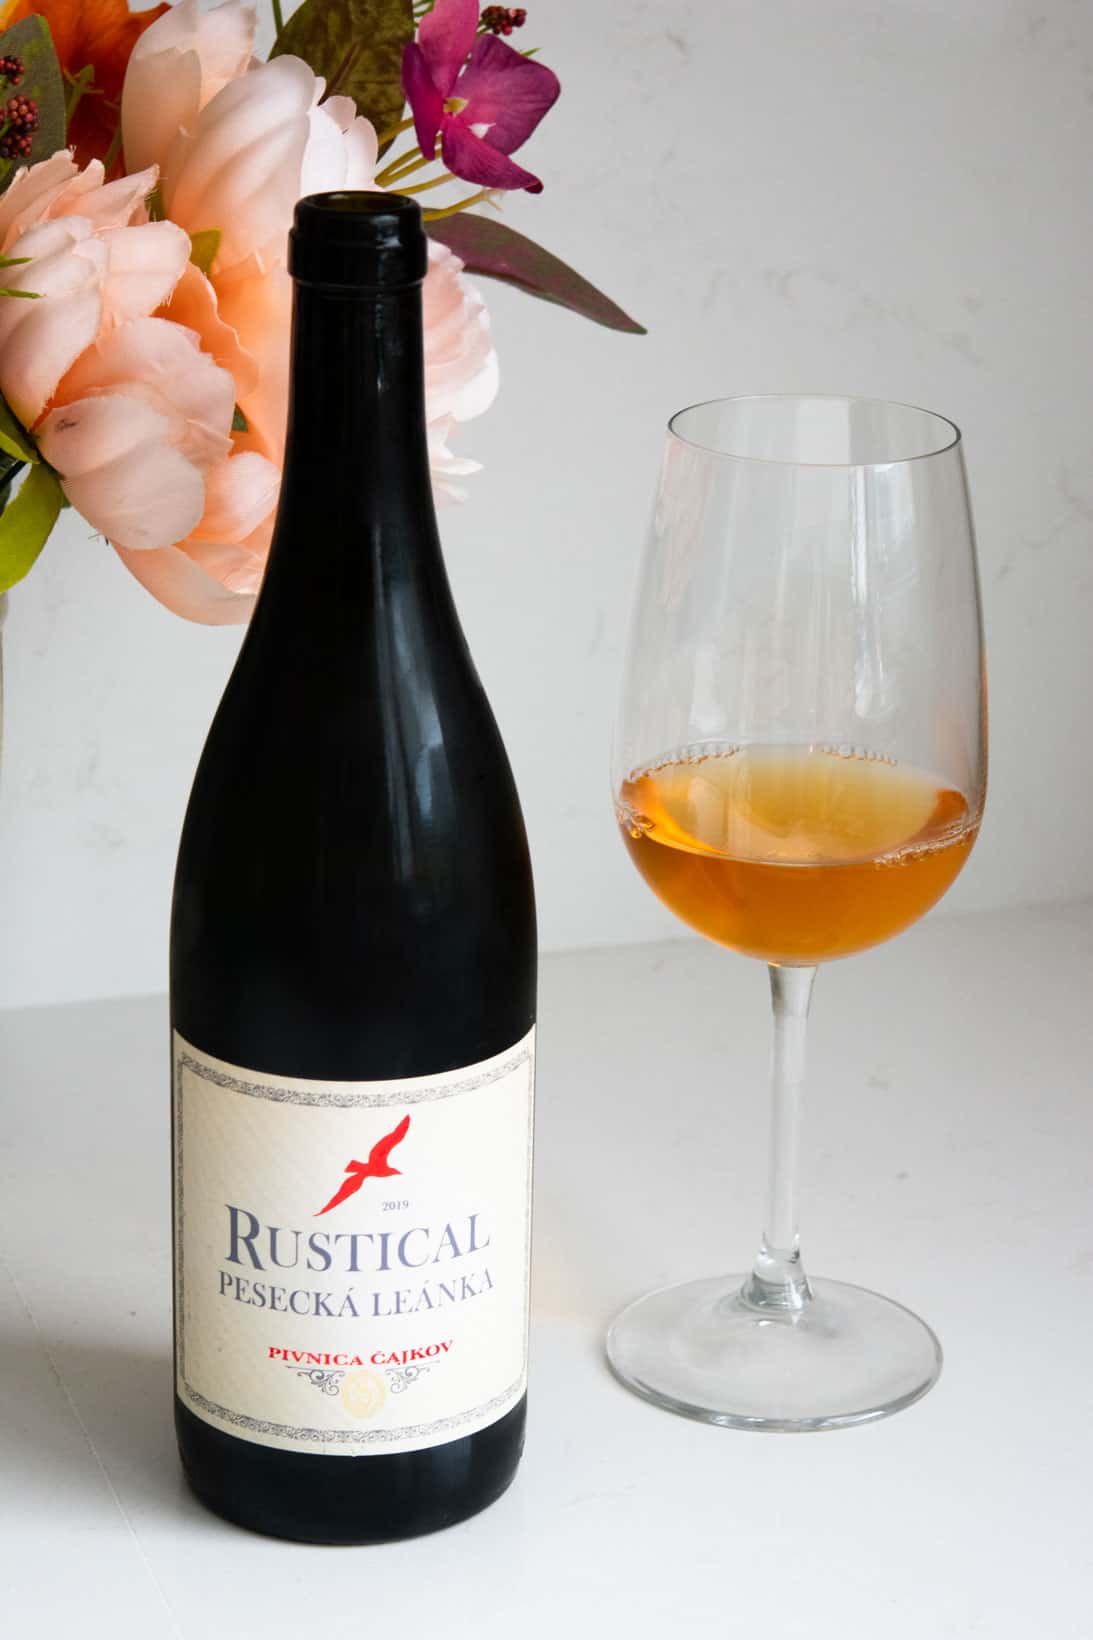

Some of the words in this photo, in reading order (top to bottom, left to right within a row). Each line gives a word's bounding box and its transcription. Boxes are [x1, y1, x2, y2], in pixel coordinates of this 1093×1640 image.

[381, 1200, 409, 1212] 2019
[225, 1204, 491, 1272] RUSTICAL
[218, 1270, 360, 1317] PESECKÁ
[371, 1268, 494, 1316] LEÁNKA
[267, 1346, 364, 1366] PIVNICA
